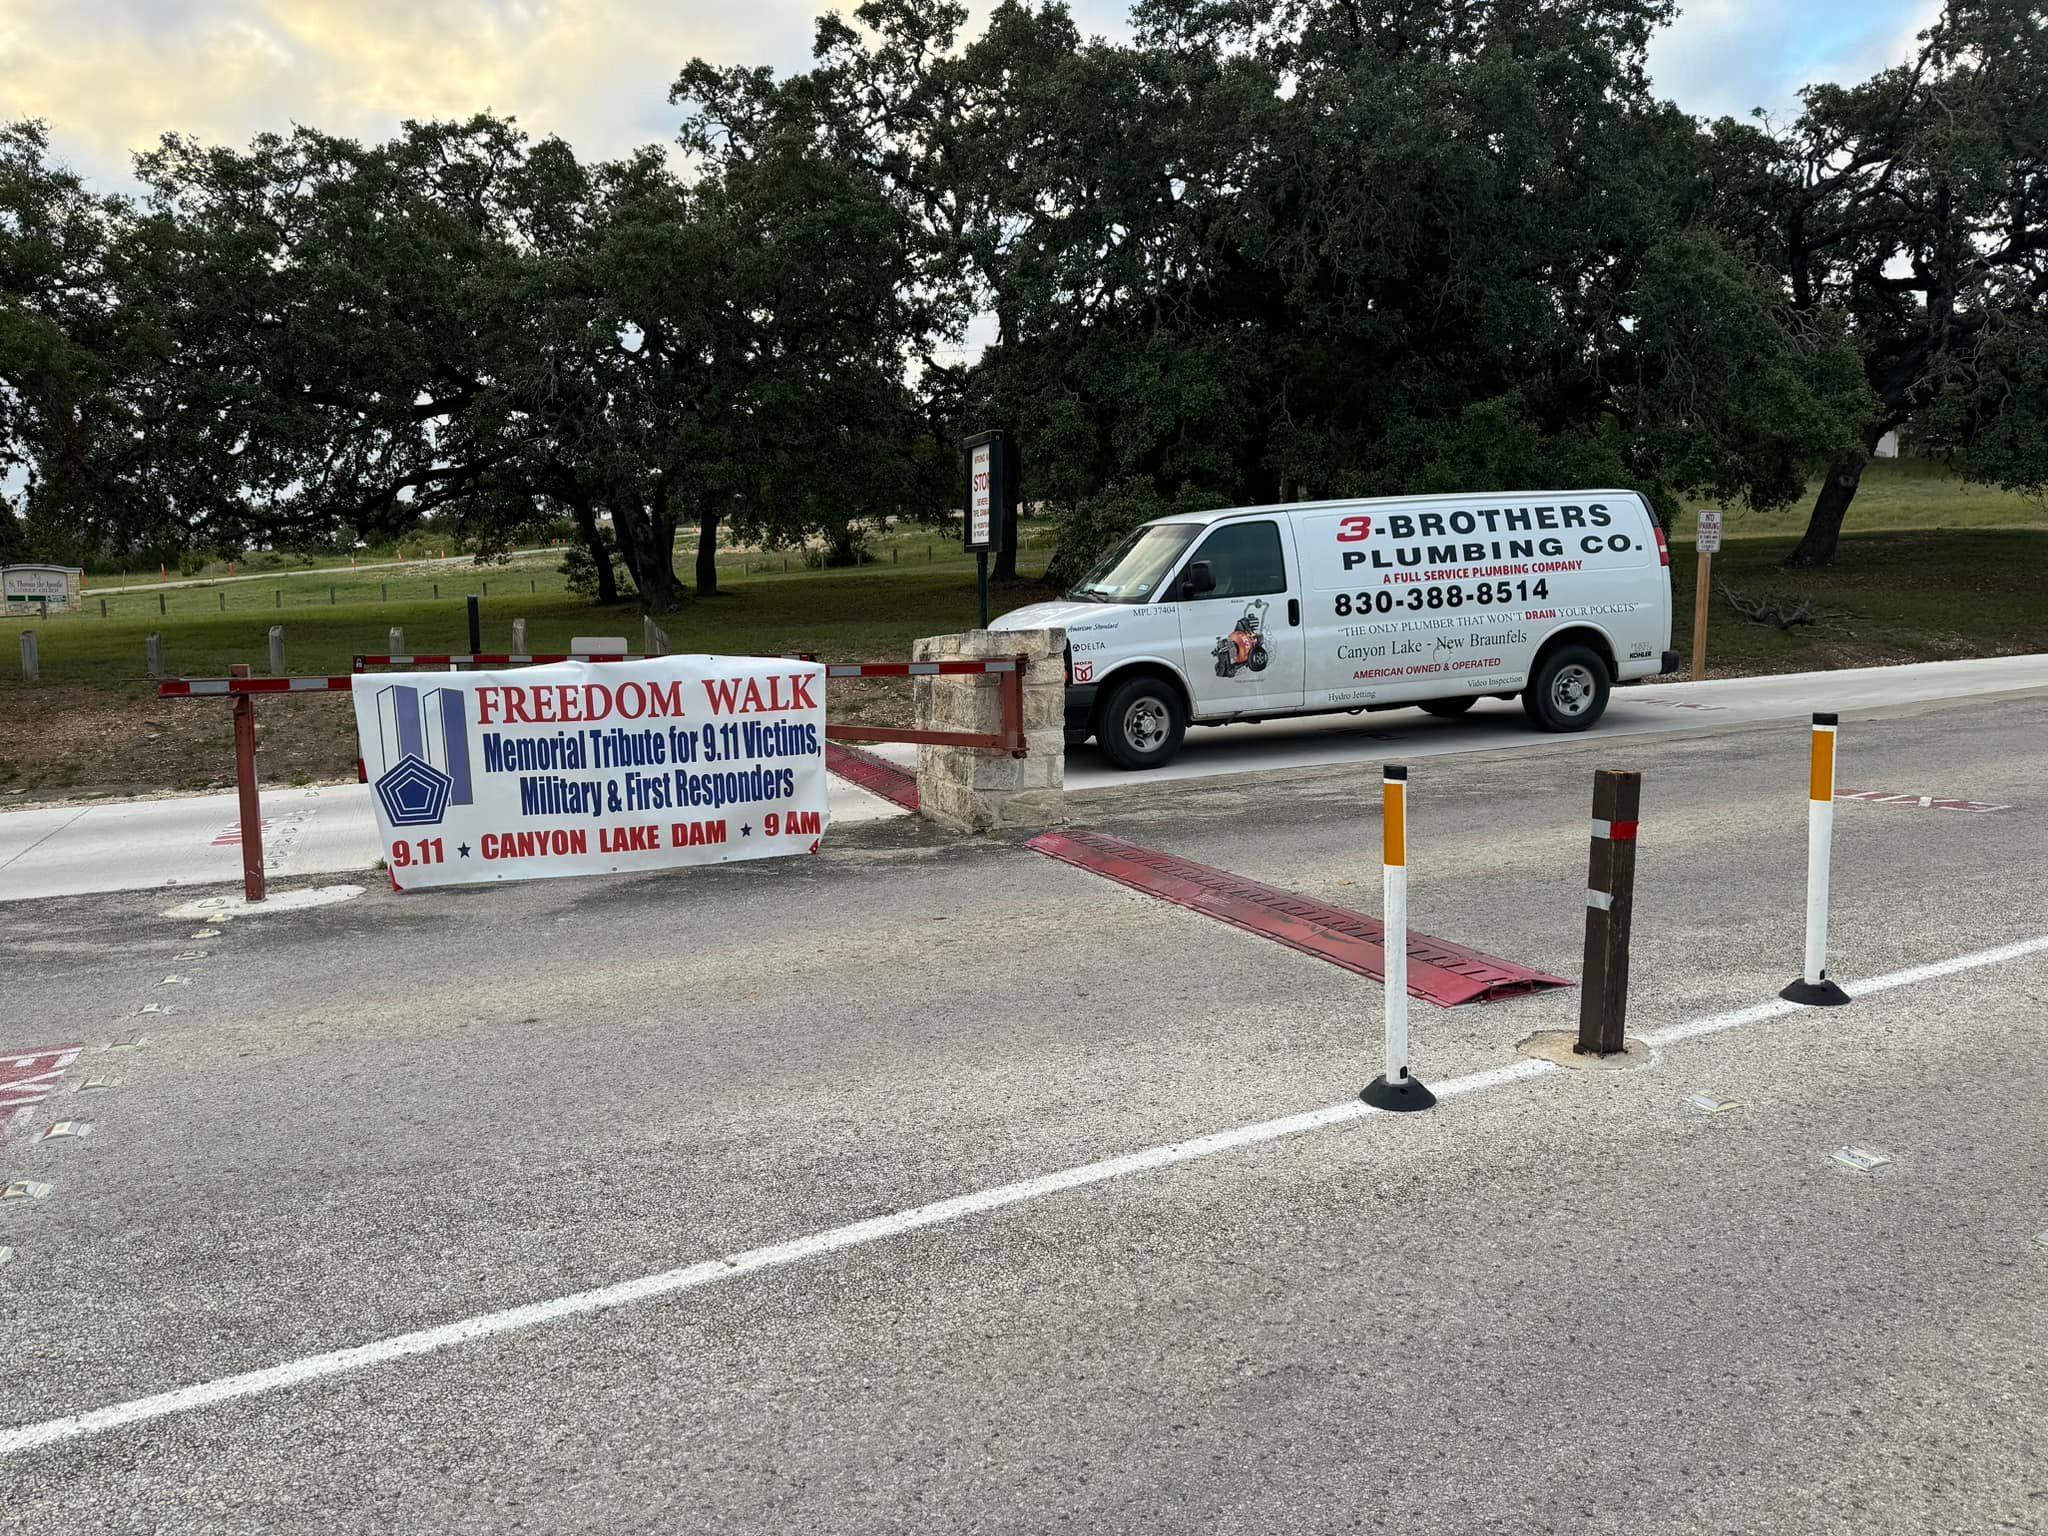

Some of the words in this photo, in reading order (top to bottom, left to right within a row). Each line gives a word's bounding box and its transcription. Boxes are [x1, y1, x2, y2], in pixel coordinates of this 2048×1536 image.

[1336, 504, 1612, 542] 3-BROTHERS
[1342, 537, 1564, 571] PLUMBING
[1580, 534, 1643, 554] CO.
[1383, 573, 1391, 584] A
[1394, 571, 1421, 584] FULL
[1424, 568, 1469, 581] SERVICE
[1472, 563, 1529, 577] PLUMBING
[1532, 560, 1583, 573] COMPANY
[1133, 608, 1151, 616] MPL
[1153, 606, 1176, 616] 37404
[1335, 578, 1549, 617] 830-388-8514
[1368, 622, 1399, 634] ONLY
[1401, 618, 1454, 632] PLUMBER
[1456, 615, 1486, 627] THAT
[1525, 609, 1557, 620] DRAIN
[1558, 606, 1588, 618] YOUR
[1080, 641, 1106, 651] DELTA
[1337, 645, 1386, 661] Canyon
[1392, 639, 1422, 655] Lake
[1436, 636, 1465, 650] New
[1470, 629, 1527, 647] Braunfels
[1353, 667, 1403, 679] AMERICAN
[1406, 663, 1440, 675] OWNED
[1443, 662, 1450, 672] &
[1452, 657, 1501, 670] OPERATED
[1467, 679, 1487, 688] Video
[1488, 676, 1523, 687] Inspection
[475, 681, 685, 724] FREEDOM
[701, 673, 818, 715] WALK
[1328, 692, 1351, 702] Hydro
[1352, 690, 1377, 699] Jetting
[483, 730, 587, 773] Memorial
[590, 728, 665, 769] Tribute
[669, 726, 698, 763] for
[703, 722, 739, 762] 9.11
[742, 719, 821, 758] Victims,
[519, 775, 601, 817] Military
[607, 780, 622, 813] &
[625, 771, 673, 811] First
[675, 764, 794, 808] Responders
[392, 837, 444, 867] 9.11
[481, 829, 587, 860] CANYON
[599, 825, 660, 854] LAKE
[671, 819, 727, 847] DAM
[764, 813, 780, 837] 9
[785, 811, 821, 835] AM
